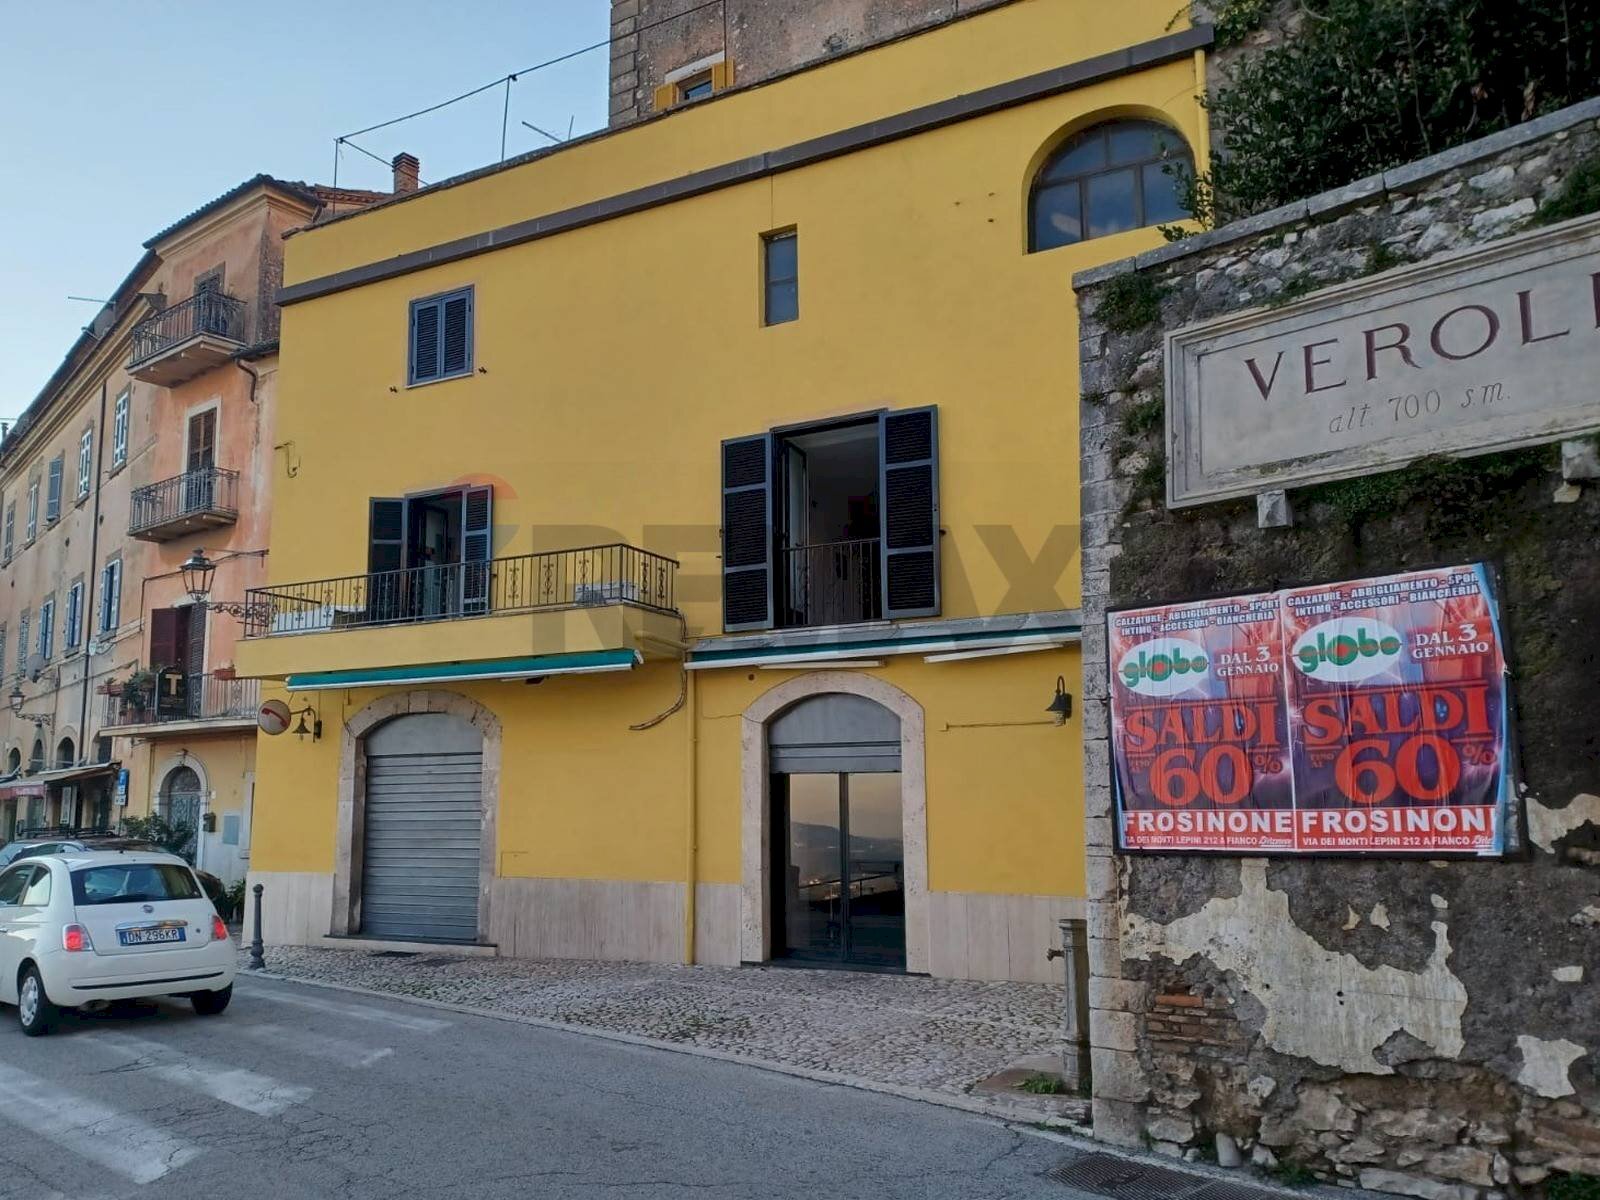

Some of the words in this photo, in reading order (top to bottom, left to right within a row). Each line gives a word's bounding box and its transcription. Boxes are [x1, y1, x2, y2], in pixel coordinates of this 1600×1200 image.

[1388, 390, 1441, 422] 700
[1287, 591, 1342, 607] CALZATURE
[1351, 577, 1439, 599] ABBIGLIAMENTO
[1295, 604, 1331, 617] INTIMO
[1339, 594, 1400, 611] ACCESSORI
[1409, 583, 1480, 603] BIANCHERIA
[1115, 614, 1162, 627] CALZATURE
[1168, 605, 1240, 621] ABBIGLIAMENTO
[1249, 598, 1280, 611] SPORT
[1121, 626, 1152, 636] INTIMO
[1160, 619, 1209, 633] ACCESSORI
[1216, 610, 1275, 626] BIANCHERIA
[1416, 629, 1454, 646] DAL
[1458, 623, 1478, 642] 3
[1220, 652, 1253, 665] DAL
[1256, 645, 1271, 662] 3
[1298, 626, 1402, 673] globo
[1413, 641, 1489, 660] GENNAIO
[1122, 647, 1209, 688] globo
[1216, 661, 1280, 678] GENNAIO
[165, 673, 182, 695] T
[1124, 702, 1280, 753] SALDI
[1303, 686, 1491, 746] SALDI
[1124, 812, 1292, 833] FROSINONE
[1302, 808, 1496, 833] FROSINON
[1151, 836, 1174, 844] MONTI
[1176, 836, 1201, 844] LEPINI
[1203, 836, 1217, 844] 212
[1227, 836, 1257, 844] FIANCO
[1302, 837, 1318, 846] VIA
[1321, 837, 1335, 846] DEI
[1338, 837, 1368, 846] MONTI
[1369, 837, 1400, 846] LEPINI
[1402, 837, 1421, 846] 212
[1423, 838, 1432, 846] A
[1432, 837, 1469, 846] FIANCO
[128, 930, 142, 943] DN
[145, 929, 178, 941] 296KR
